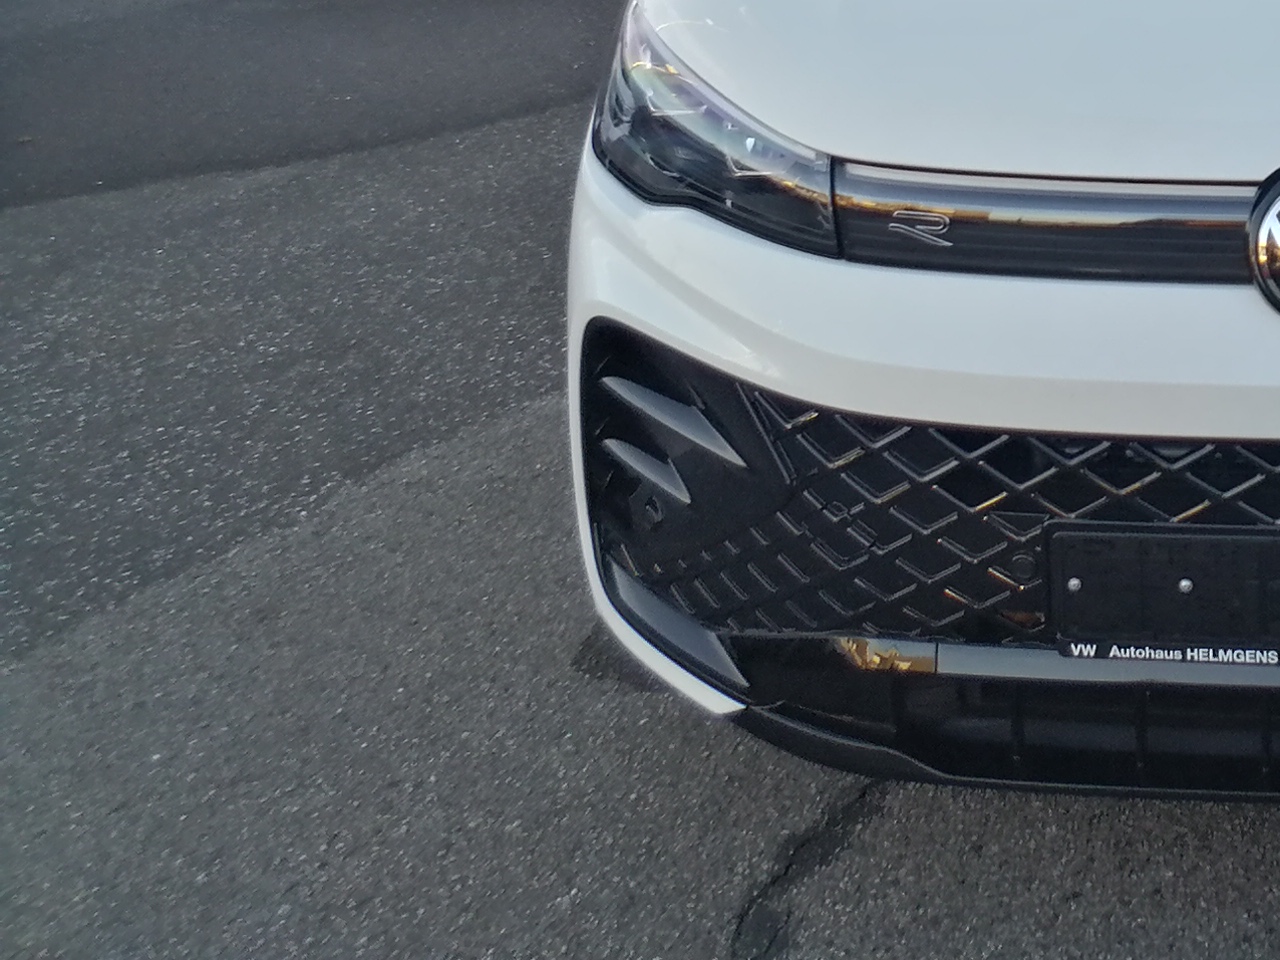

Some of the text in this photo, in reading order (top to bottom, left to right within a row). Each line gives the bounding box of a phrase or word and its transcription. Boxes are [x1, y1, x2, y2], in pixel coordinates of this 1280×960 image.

[1070, 643, 1097, 657] VW
[1109, 645, 1183, 660] Autohaus
[1186, 647, 1279, 664] HELMGENS
